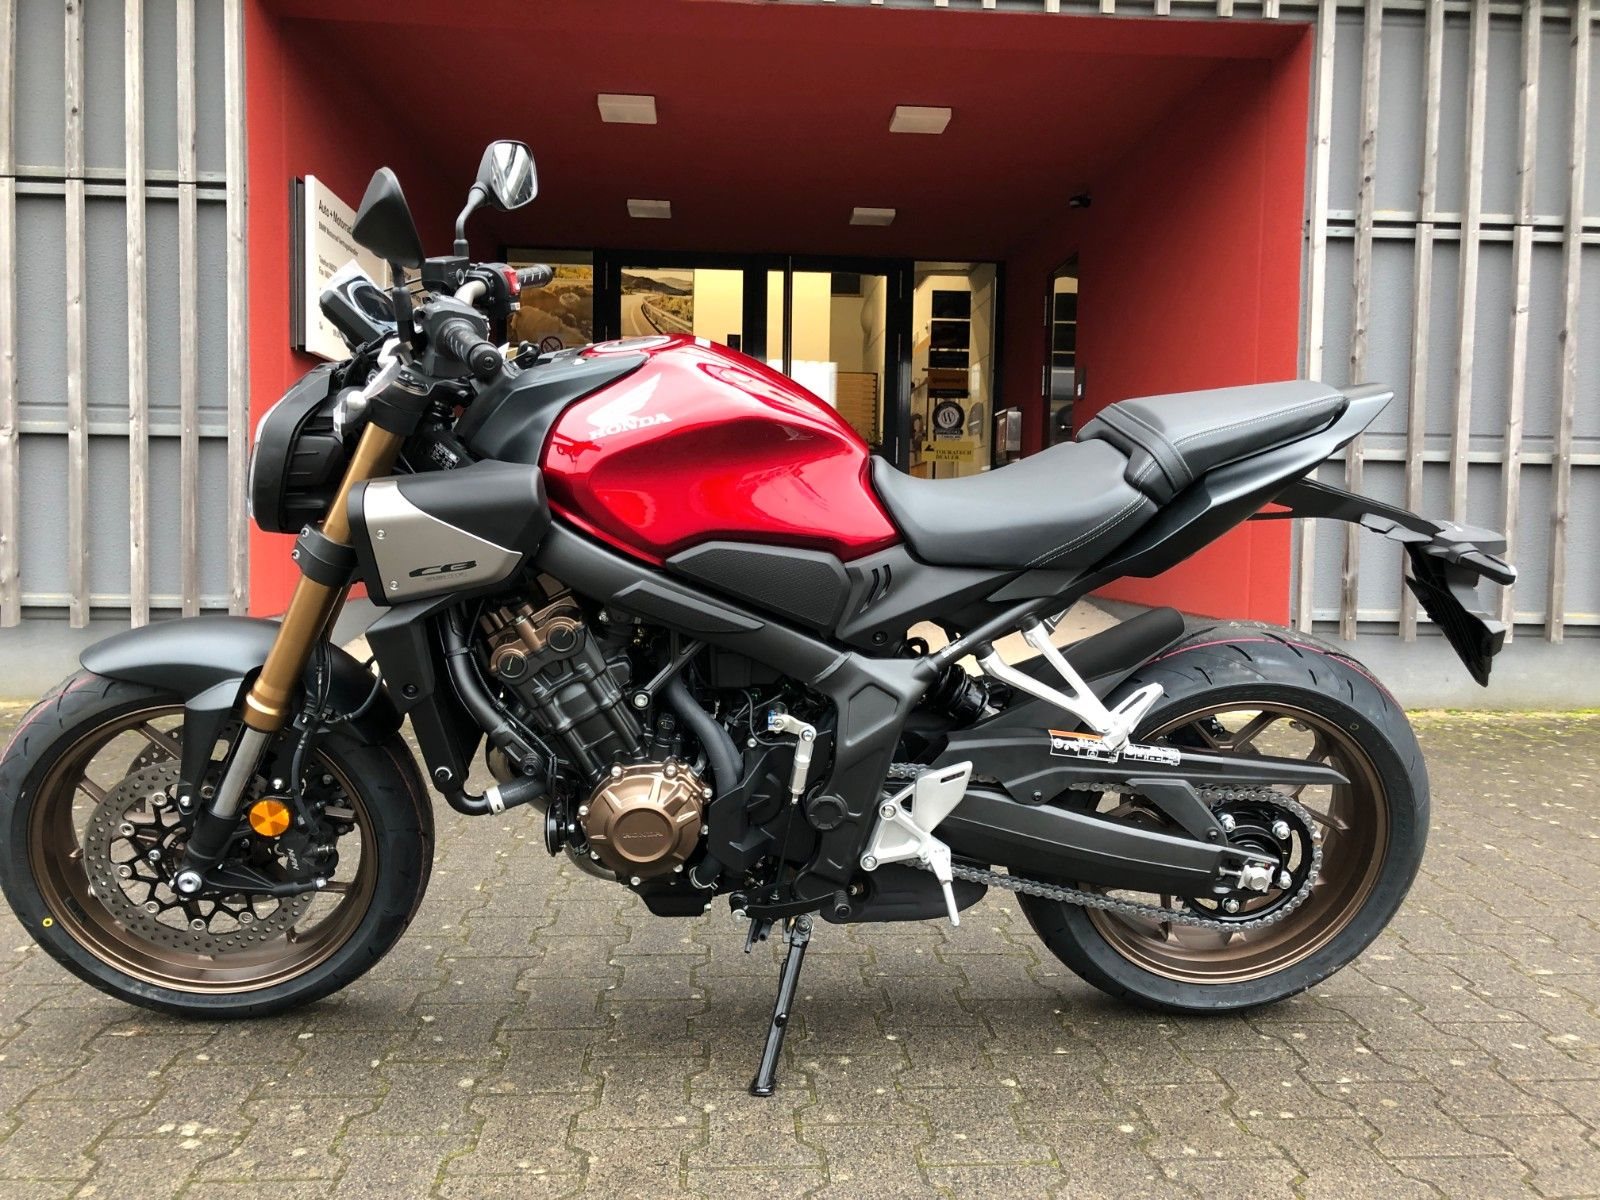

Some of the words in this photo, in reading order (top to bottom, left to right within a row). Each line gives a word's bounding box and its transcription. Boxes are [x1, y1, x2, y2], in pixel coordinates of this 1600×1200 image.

[318, 200, 330, 218] Auto
[588, 412, 673, 441] HONDA
[408, 560, 478, 578] CB
